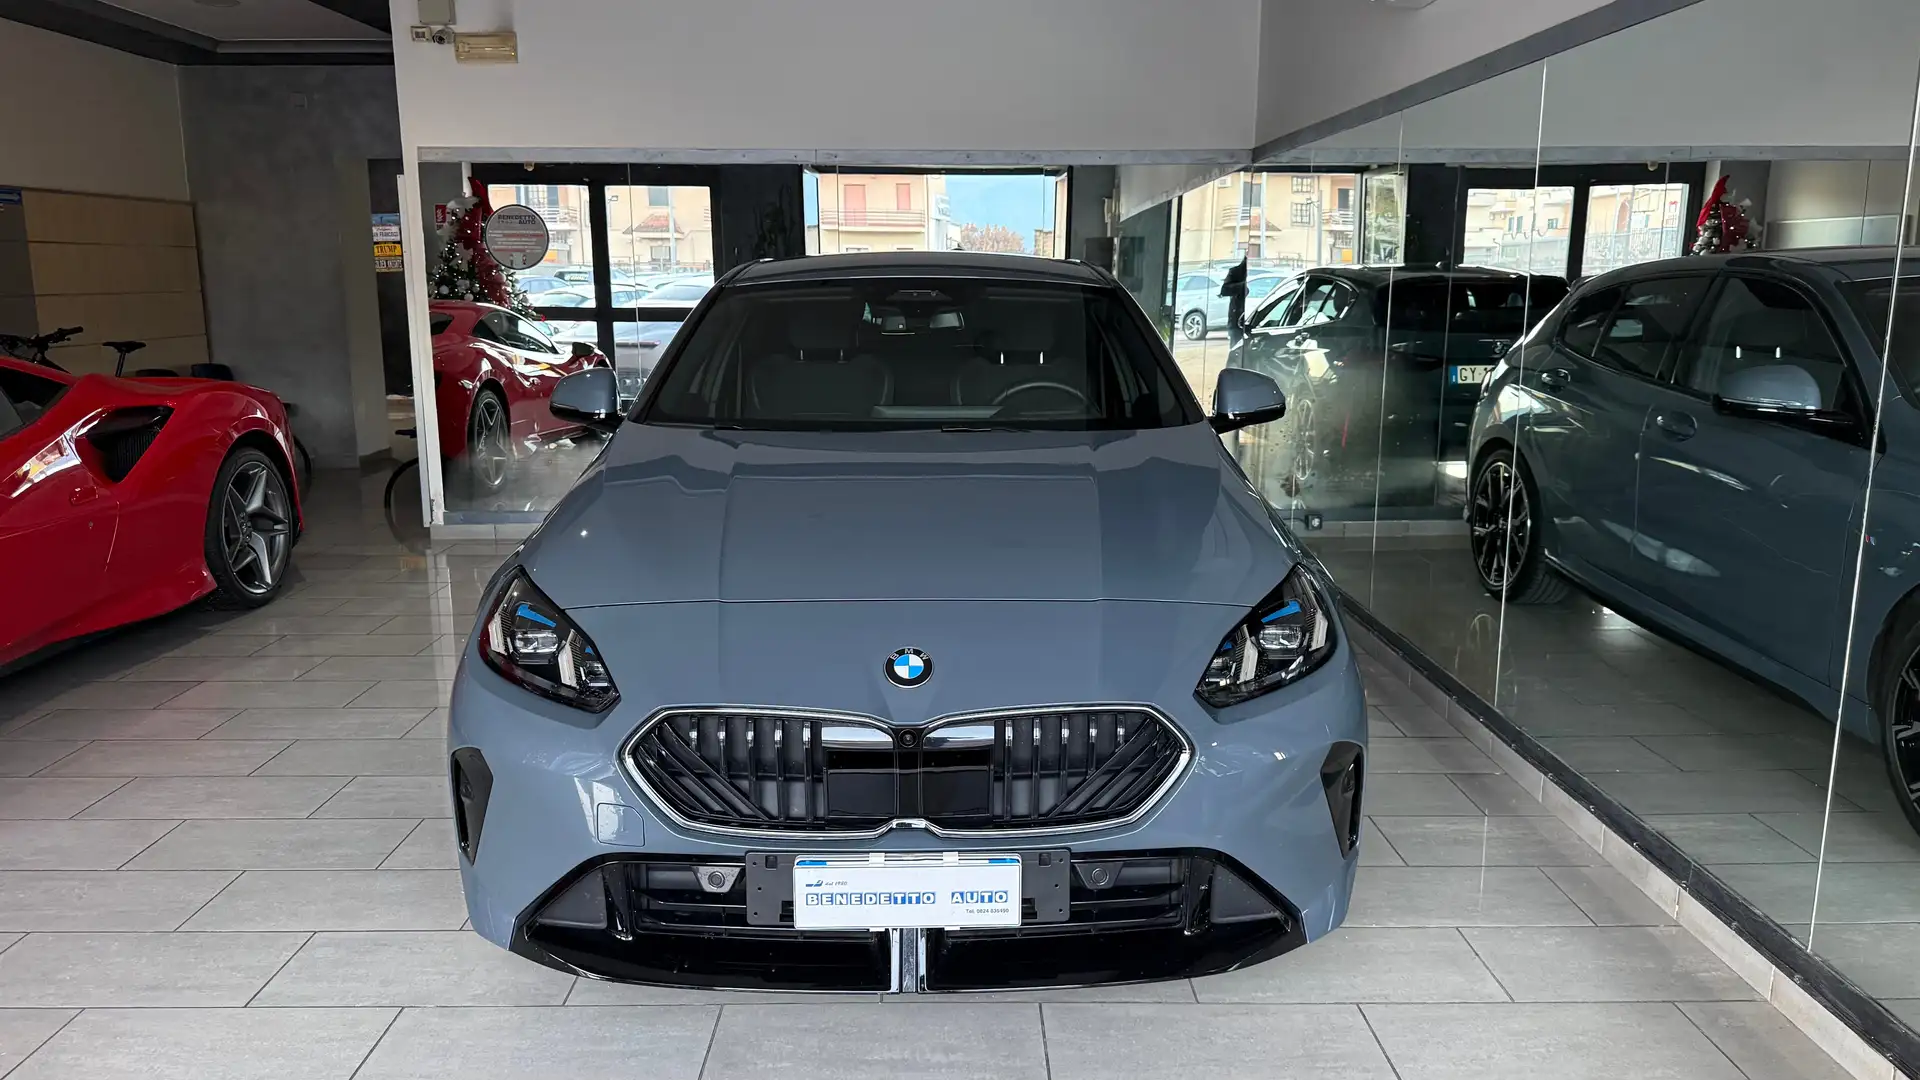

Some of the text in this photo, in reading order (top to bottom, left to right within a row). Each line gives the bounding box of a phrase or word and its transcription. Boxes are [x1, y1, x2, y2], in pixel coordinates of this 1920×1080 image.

[376, 245, 397, 254] TRUMP
[889, 648, 930, 661] BMW
[805, 890, 1009, 906] BENEDETTO AUTO
